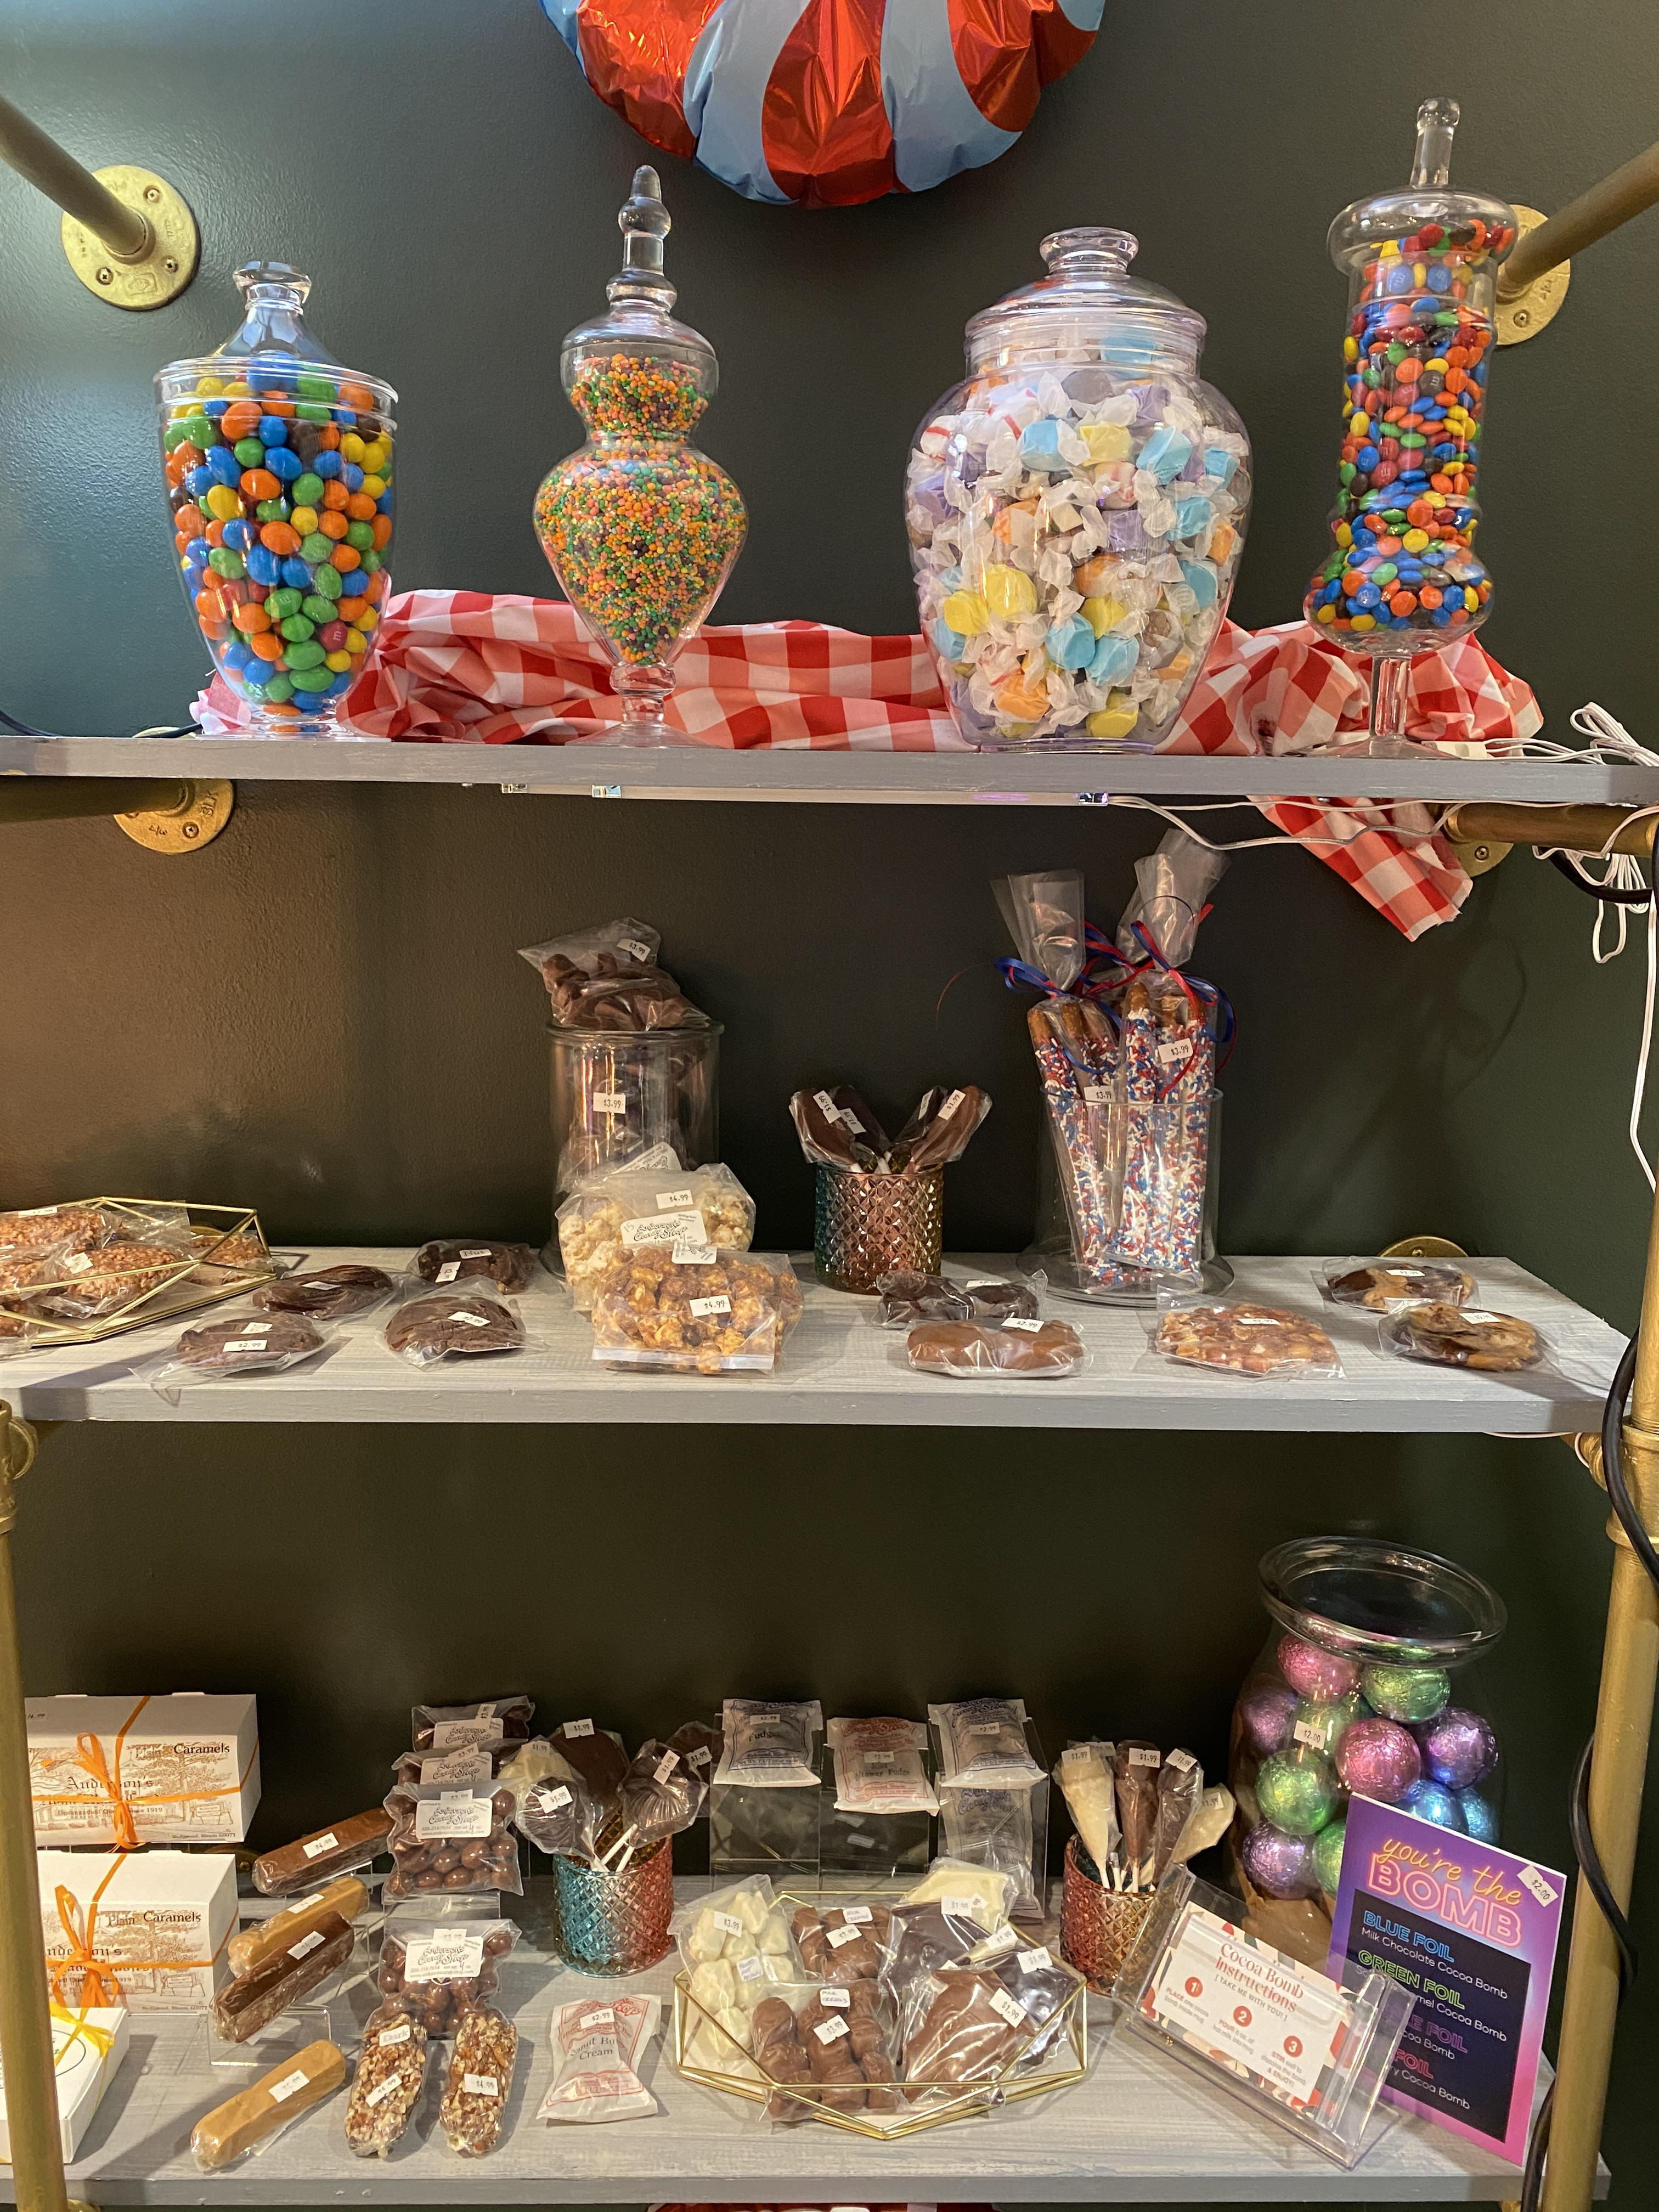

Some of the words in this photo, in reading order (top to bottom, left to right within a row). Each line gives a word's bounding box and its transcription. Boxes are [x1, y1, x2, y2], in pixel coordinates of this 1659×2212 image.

[333, 631, 341, 641] m
[1171, 1045, 1189, 1056] $3.99
[946, 1093, 961, 1109] $1.99
[1096, 1091, 1112, 1099] $3.99
[603, 1099, 622, 1108] $3.99
[819, 1095, 832, 1111] $1.99
[669, 1194, 689, 1203] $4.99
[637, 1219, 681, 1232] Anderson's
[704, 1300, 725, 1309] $4.99
[574, 1723, 591, 1732] $1.99
[1304, 1730, 1321, 1743] $2.00
[173, 1742, 230, 1754] Caramels
[532, 1743, 548, 1752] $1.99
[691, 1751, 707, 1762] $1.99
[1071, 1751, 1087, 1760] $1.99
[1139, 1753, 1157, 1763] $1.99
[1177, 1756, 1192, 1767] $1.99
[662, 1756, 674, 1773] $1.99
[888, 1768, 911, 1776] Fudge
[66, 1776, 153, 1790] Andon's
[550, 1792, 567, 1803] $1.99
[1376, 1838, 1463, 1881] you're
[1473, 1865, 1522, 1905] the
[1532, 1878, 1551, 1901] $2.00
[1368, 1852, 1522, 1948] BOMB
[108, 1914, 135, 1926] Plain
[143, 1910, 201, 1923] Caramels
[724, 1918, 740, 1931] $3.99
[1363, 1910, 1411, 1943] BLUE
[1413, 1931, 1455, 1963] FOIL
[47, 1944, 123, 1956] ndeon's
[1361, 1927, 1380, 1942] Milk
[1382, 1937, 1436, 1967] Chocolate
[1437, 1961, 1474, 1984] Cocoa
[1475, 1977, 1509, 2000] Bomb
[1220, 1943, 1262, 1977] Cocoa
[1265, 1967, 1304, 1999] Bomb
[1215, 1956, 1297, 2013] Instructions
[1358, 1949, 1420, 1989] GREEN
[1423, 1977, 1465, 2011] FOIL
[1166, 1987, 1185, 2002] PLACE
[1220, 1976, 1237, 1991] TAKE
[1237, 1987, 1248, 1997] ME
[1249, 1994, 1266, 2008] WITH
[1267, 2004, 1284, 2018] YOU!
[592, 2012, 611, 2021] $2.99
[1002, 2002, 1020, 2019] $1.99
[1237, 2010, 1247, 2023] 2
[1436, 2002, 1472, 2026] Cocoa
[1475, 2019, 1508, 2042] Bomb
[383, 2028, 410, 2042] Dark
[1426, 2021, 1468, 2054] FOIL
[1288, 2040, 1298, 2053] 3
[1402, 2030, 1422, 2044] coa
[1424, 2038, 1455, 2060] Bomb
[579, 2048, 613, 2060] Cream
[1394, 2048, 1434, 2080] FOIL
[1402, 2069, 1436, 2094] Cocoa
[1438, 2087, 1471, 2111] Bomb
